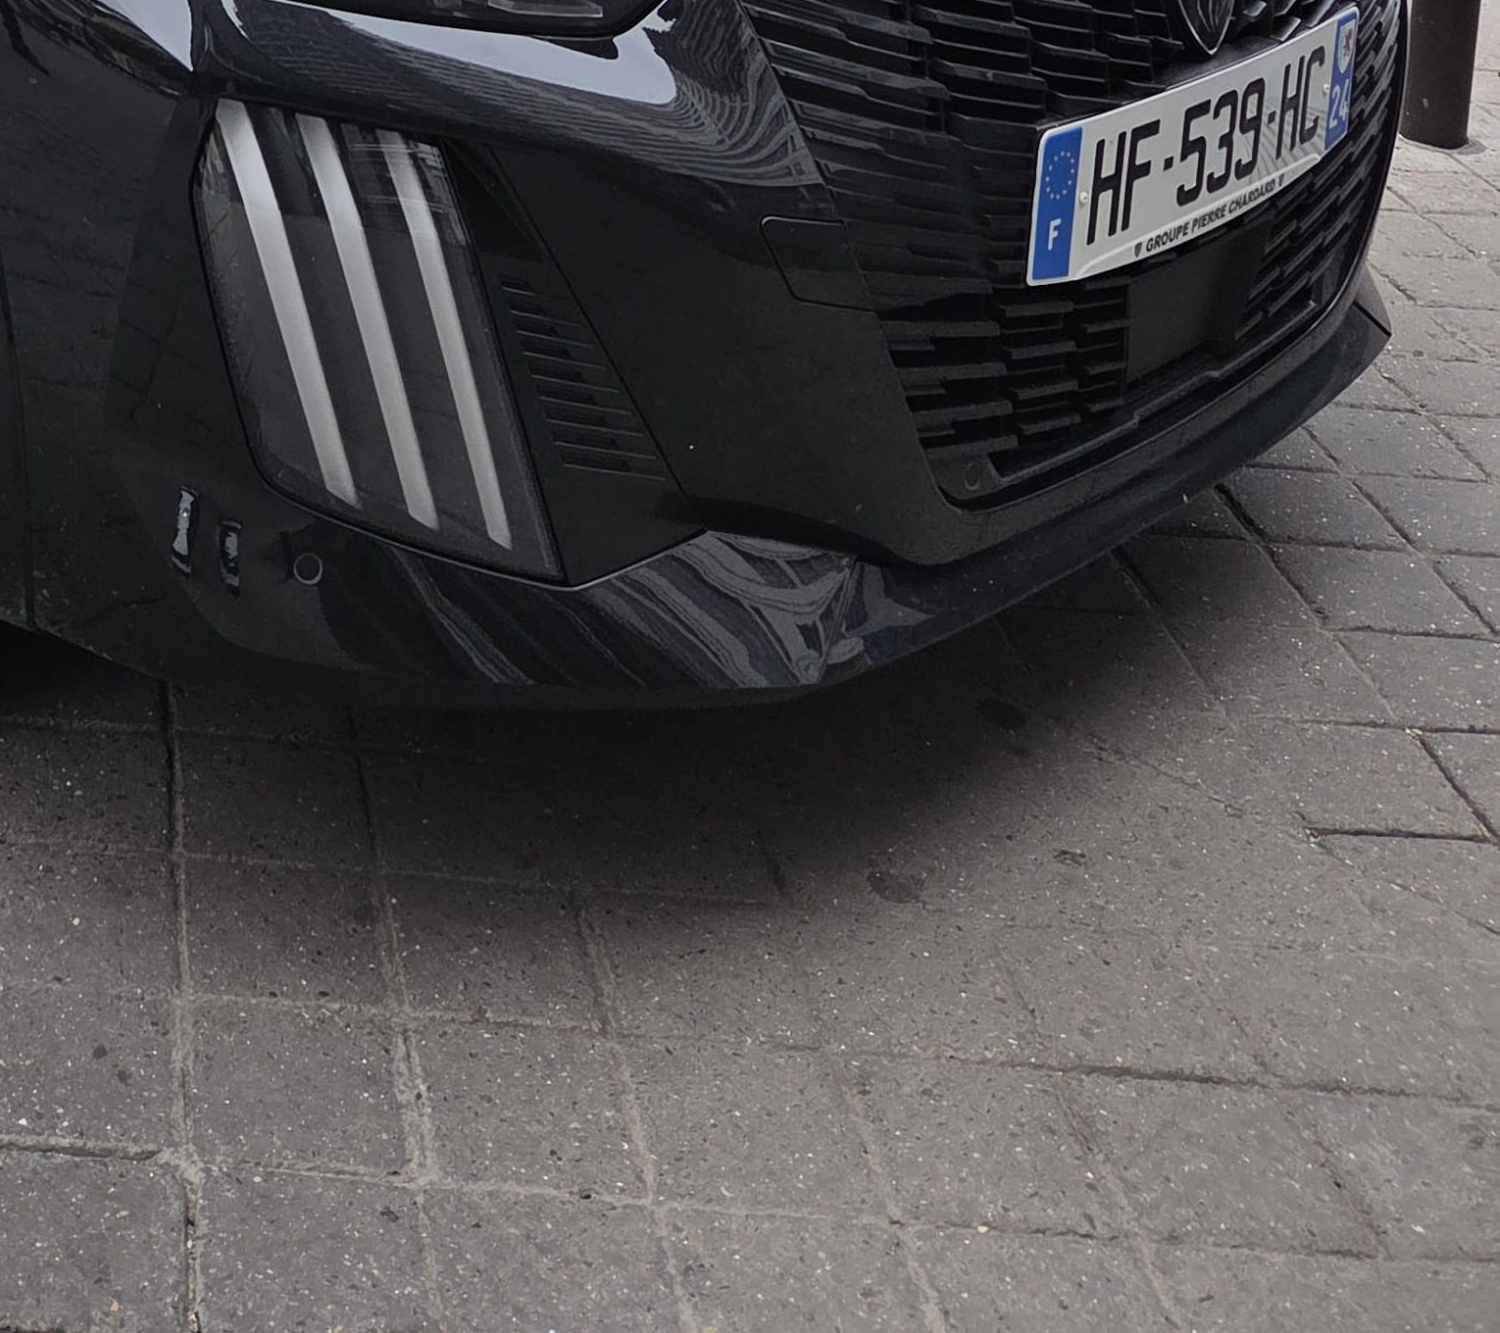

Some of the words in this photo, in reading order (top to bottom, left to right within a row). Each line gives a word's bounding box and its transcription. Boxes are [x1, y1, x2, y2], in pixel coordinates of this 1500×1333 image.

[1328, 85, 1351, 129] 24
[1086, 45, 1325, 245] HF-539-HC
[1047, 218, 1061, 250] F
[1145, 223, 1190, 252] GROUPE
[1191, 204, 1227, 233] PIERRE
